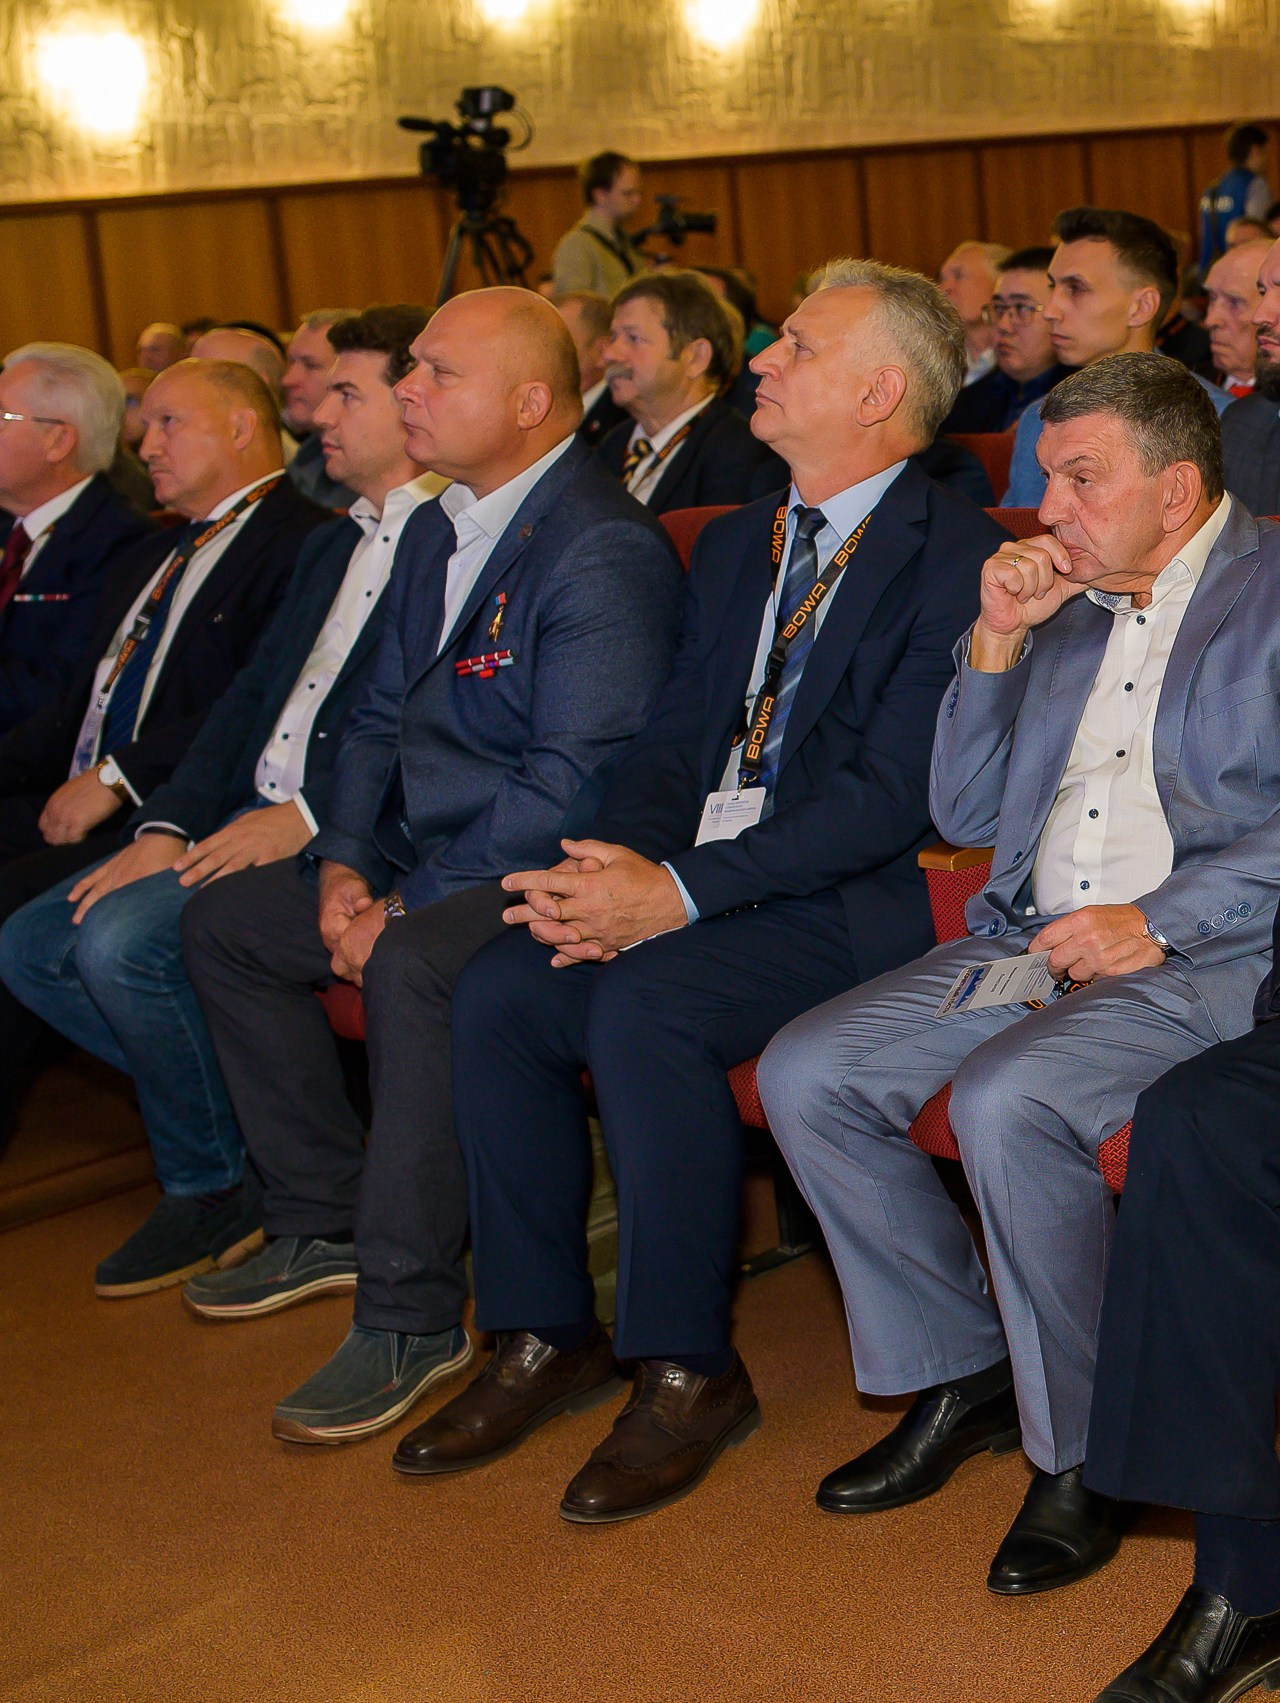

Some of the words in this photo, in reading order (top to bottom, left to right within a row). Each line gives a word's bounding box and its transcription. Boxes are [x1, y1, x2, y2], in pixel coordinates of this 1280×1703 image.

[834, 514, 872, 567] BOW
[783, 582, 827, 639] BOWA
[746, 696, 775, 760] BOWA
